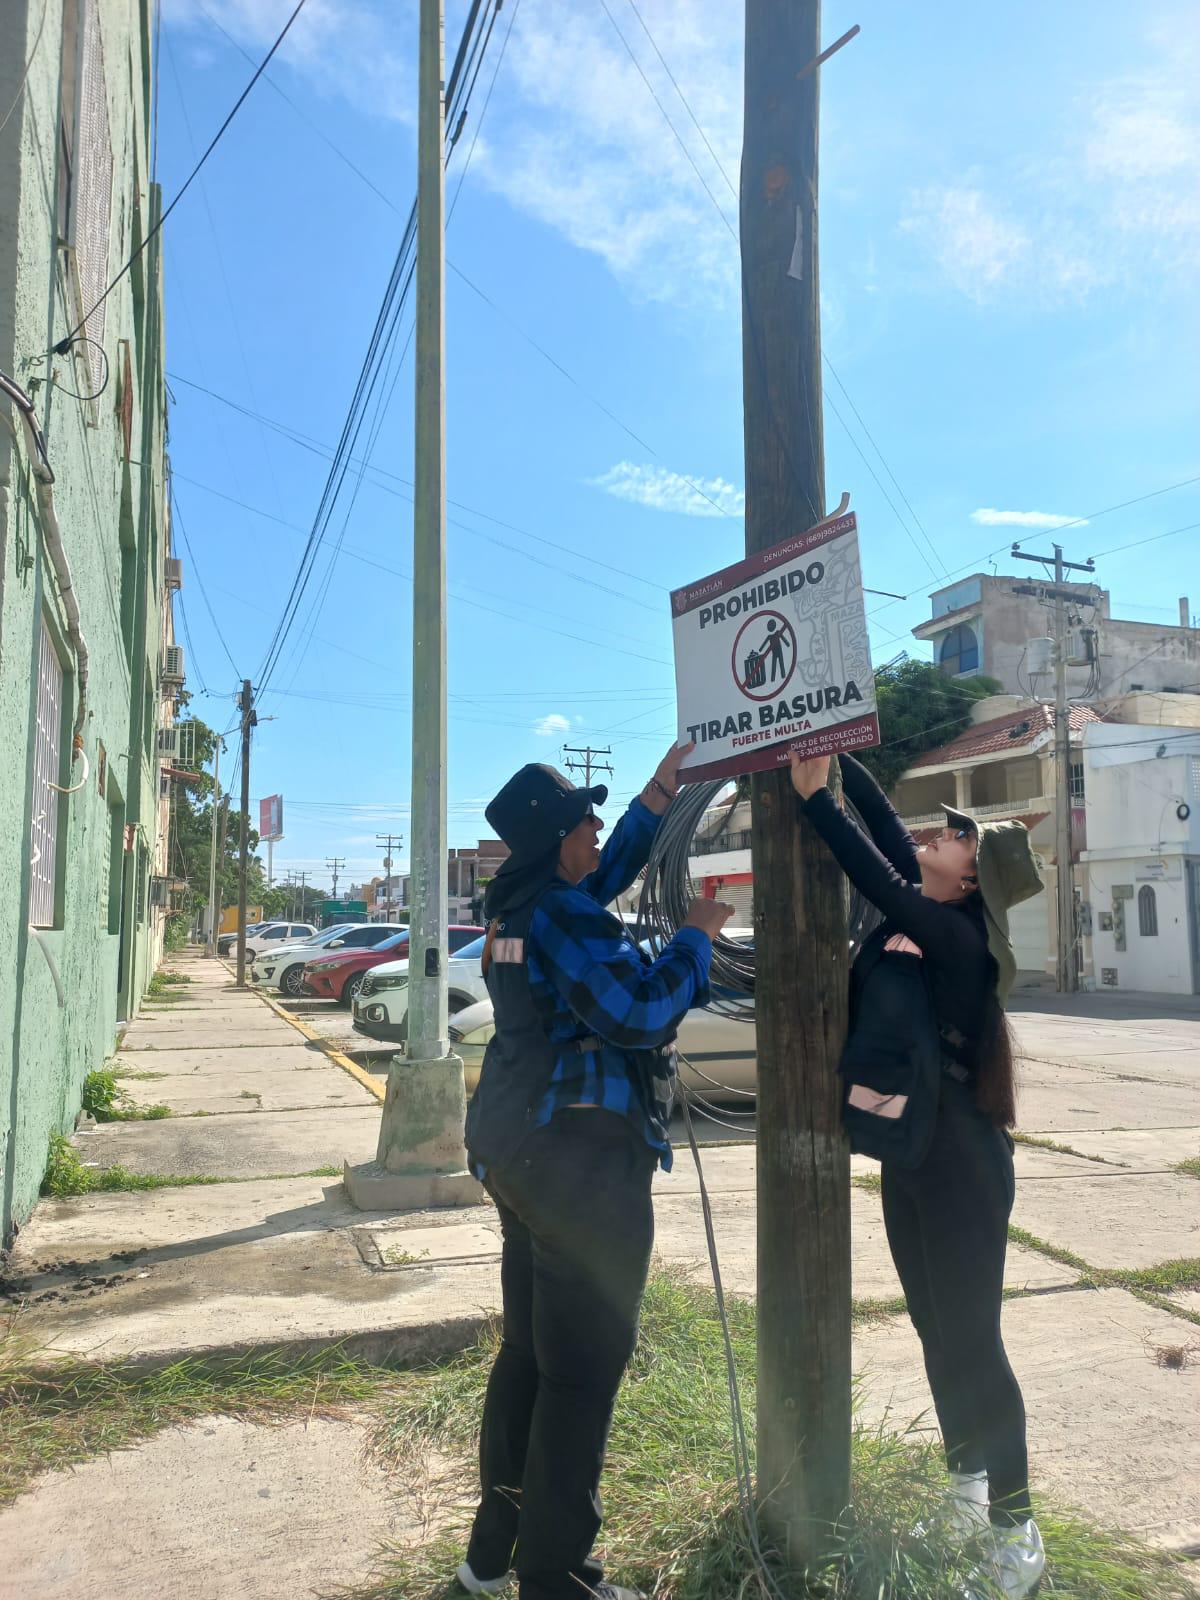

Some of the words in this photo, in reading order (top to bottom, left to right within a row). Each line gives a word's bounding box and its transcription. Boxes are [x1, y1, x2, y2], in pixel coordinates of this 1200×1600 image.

[699, 561, 825, 630] PROHIBIDO
[687, 711, 753, 745] TIRAR
[758, 680, 863, 727] BASURA
[732, 729, 771, 748] FUERTE
[774, 719, 812, 737] MULTA
[808, 737, 818, 746] DE
